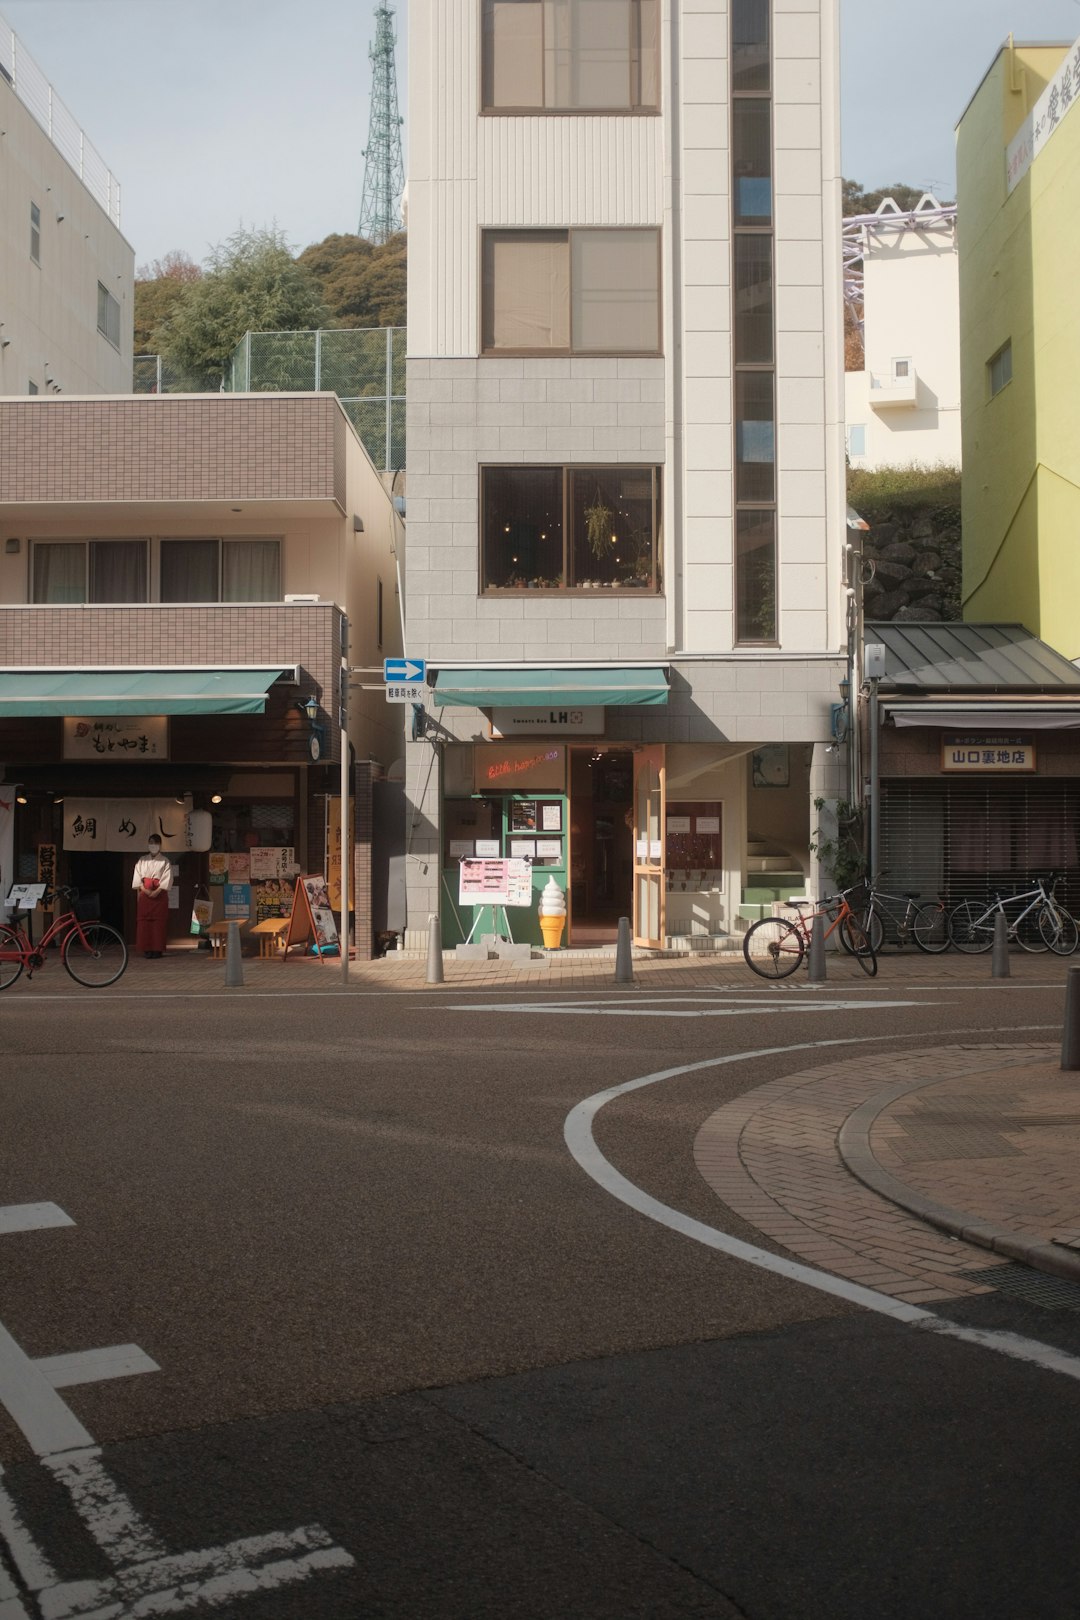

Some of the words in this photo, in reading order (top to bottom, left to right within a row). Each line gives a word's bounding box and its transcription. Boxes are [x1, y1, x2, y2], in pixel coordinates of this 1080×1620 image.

[388, 687, 422, 698] 軽車両を除く
[549, 711, 568, 723] LH
[92, 734, 149, 753] もとやま
[952, 750, 1025, 764] 山口裏地店
[72, 814, 176, 840] 鯛めし
